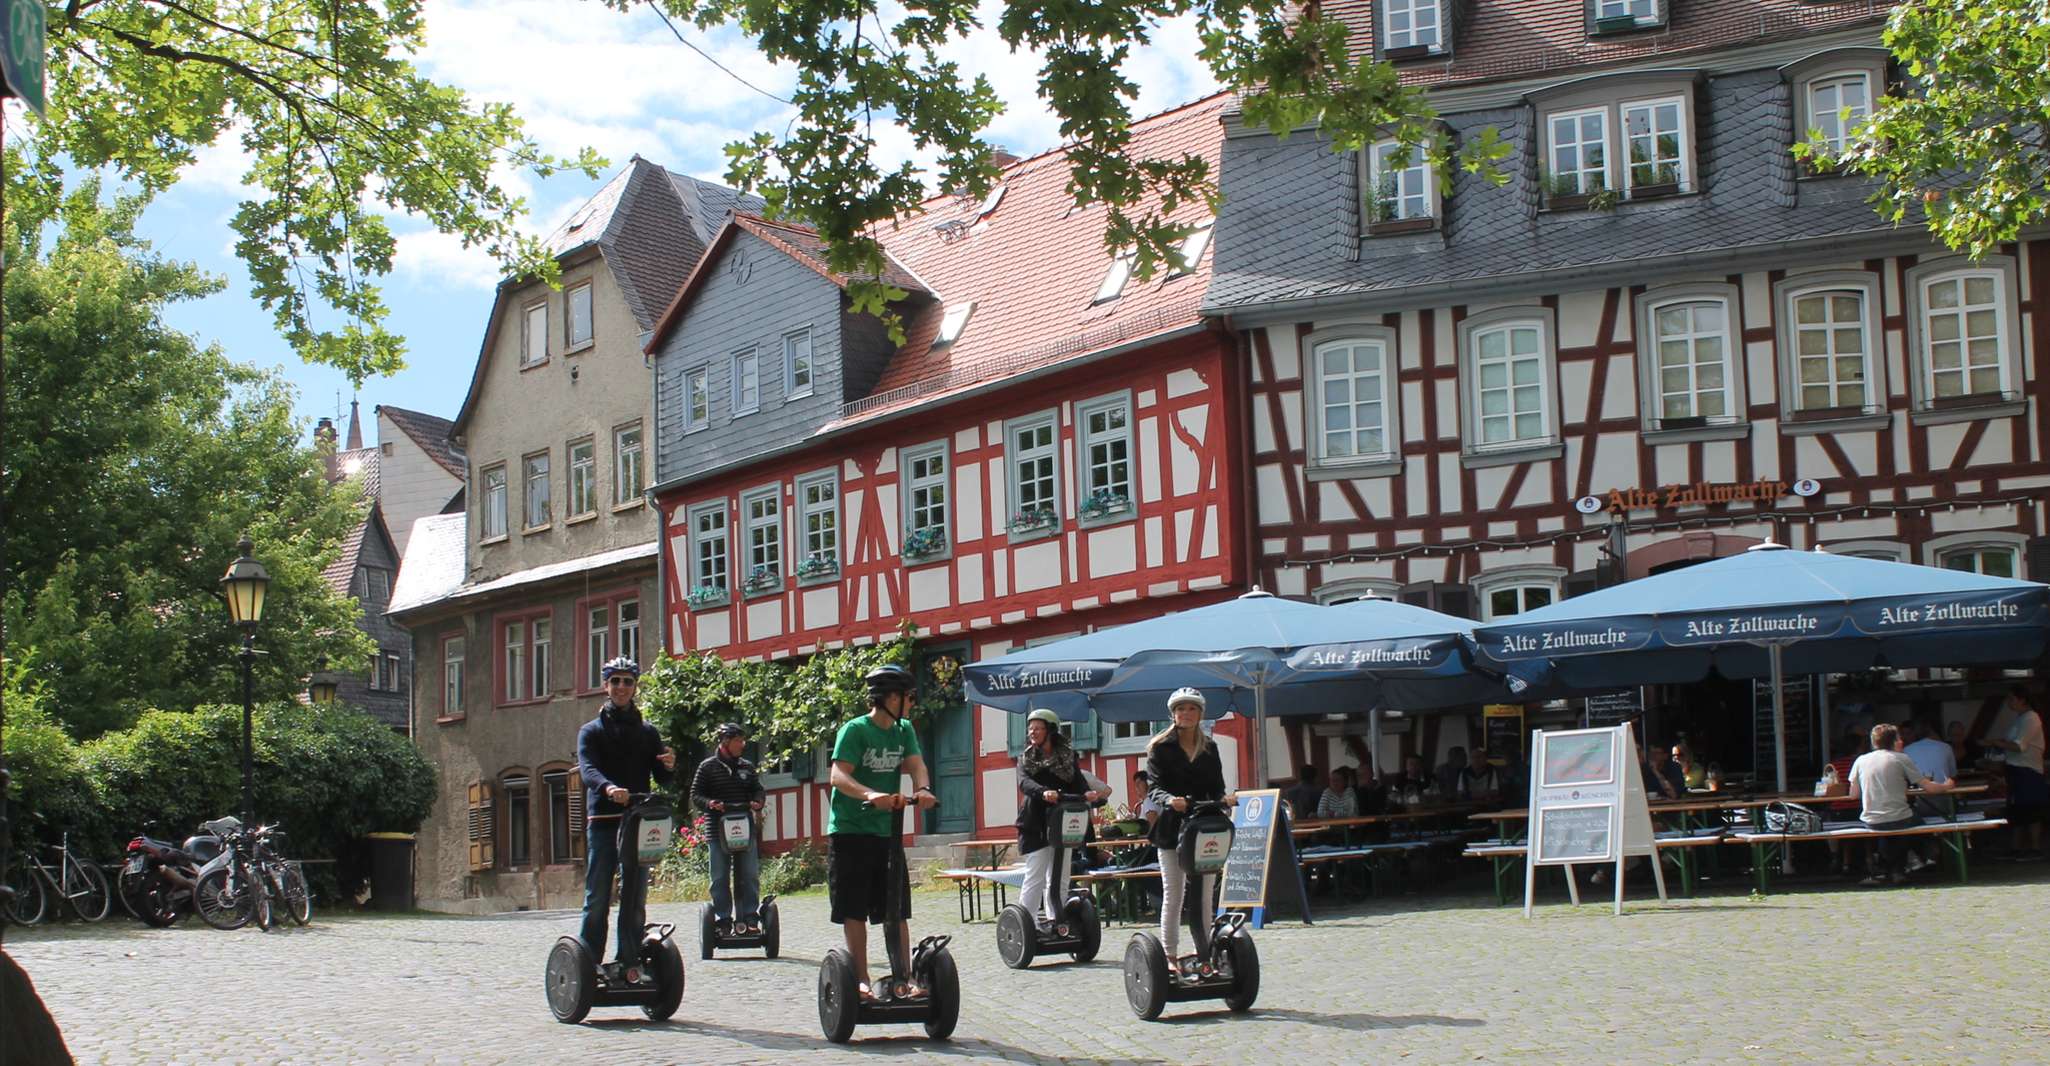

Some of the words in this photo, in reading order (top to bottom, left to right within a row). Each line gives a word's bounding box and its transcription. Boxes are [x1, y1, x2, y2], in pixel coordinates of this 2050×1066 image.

[1606, 487, 1658, 513] Alte
[1664, 476, 1789, 508] Zollwache
[1685, 620, 1724, 637] Alte
[1728, 613, 1818, 634] Zollwache
[1879, 607, 1920, 625] Alte
[1924, 600, 2018, 621] Zollwache
[1501, 635, 1537, 653] Alte
[1541, 627, 1627, 650] Zollwache
[1309, 651, 1345, 666] Alte
[1350, 645, 1432, 665] Zollwache
[988, 673, 1016, 691] Alte
[1020, 666, 1093, 689] Zollwache
